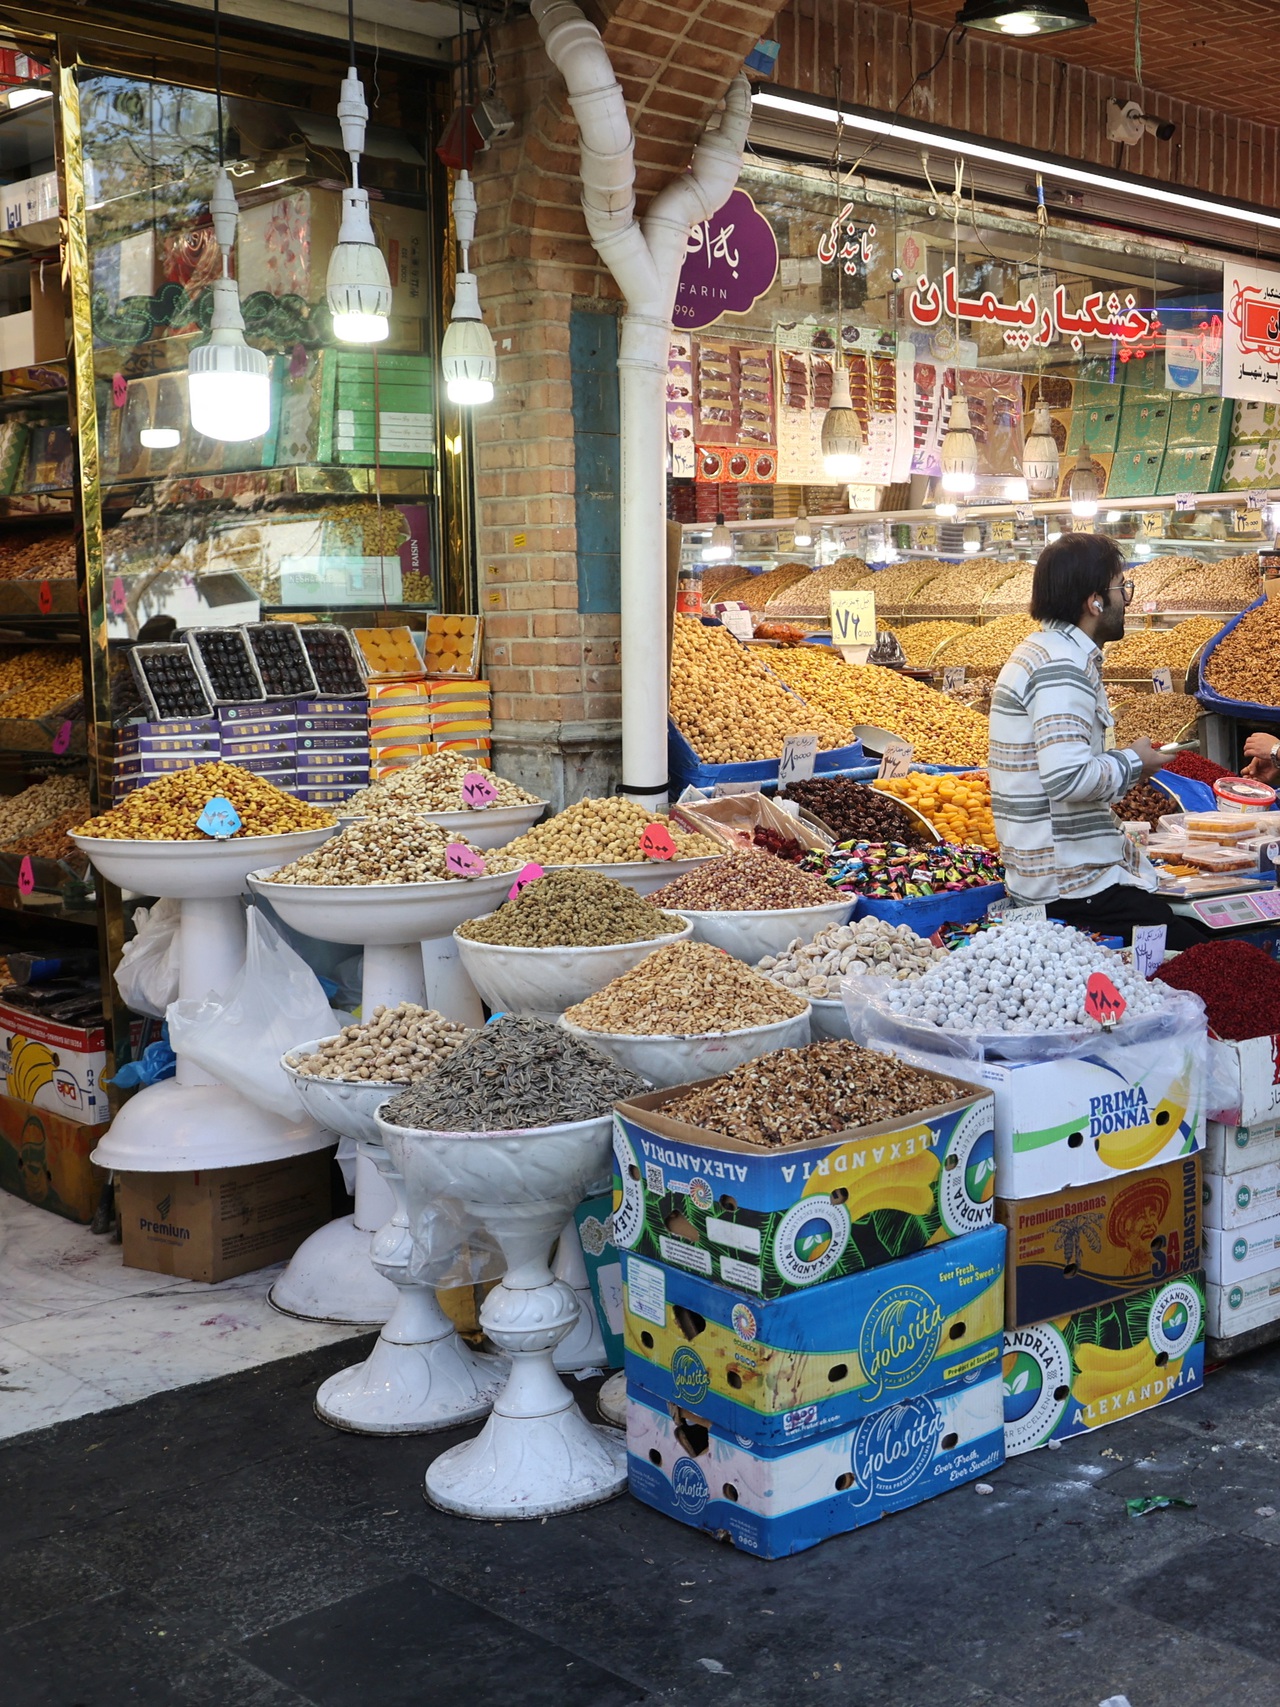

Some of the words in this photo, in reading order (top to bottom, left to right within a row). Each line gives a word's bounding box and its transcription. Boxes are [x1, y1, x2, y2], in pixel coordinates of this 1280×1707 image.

[817, 203, 877, 276] نمایندگی
[679, 282, 728, 300] FARIN
[673, 303, 695, 318] 996
[909, 266, 1038, 352] پیمان
[1032, 284, 1150, 352] خشکبار
[411, 539, 419, 568] RAISIN
[464, 783, 492, 797] ۷۴۰
[1089, 990, 1120, 1011] ۲۸۰
[57, 1081, 77, 1101] Dole
[1089, 1086, 1149, 1117] PRIMA
[1089, 1106, 1150, 1138] DONNA
[640, 1138, 748, 1183] ALEXANDRIA
[780, 1127, 941, 1184] ALEXANDRIA
[953, 1186, 993, 1224] ANDRIA
[1018, 1207, 1064, 1230] Premium
[1065, 1194, 1107, 1216] Bananas
[1238, 1193, 1249, 1203] 5kg
[139, 1217, 191, 1240] Premium
[1183, 1160, 1196, 1273] SEBASTIANO
[1018, 1232, 1045, 1245] PRODUCT
[1018, 1247, 1046, 1260] ECUADOR
[1234, 1245, 1246, 1255] 5kg
[786, 1238, 842, 1276] ALEXANDRIA
[938, 1271, 955, 1283] Ever
[958, 1276, 974, 1287] Ever
[1155, 1291, 1194, 1323] ALEXANDRIA
[1230, 1293, 1241, 1303] 5kg
[947, 1363, 970, 1376] Product
[976, 1350, 997, 1365] Ecuador
[1003, 1332, 1055, 1370] ANDRIA
[1017, 1384, 1056, 1436] EXCELLENCE
[1071, 1366, 1196, 1425] ALEXANDRIA
[875, 1482, 894, 1490] EXTRA
[893, 1470, 917, 1489] PREMIUM
[916, 1440, 932, 1472] BANANAS
[933, 1460, 953, 1476] Ever
[953, 1449, 980, 1468] Fresh,
[949, 1467, 968, 1482] Ever
[969, 1450, 1000, 1474] Sweet!!!
